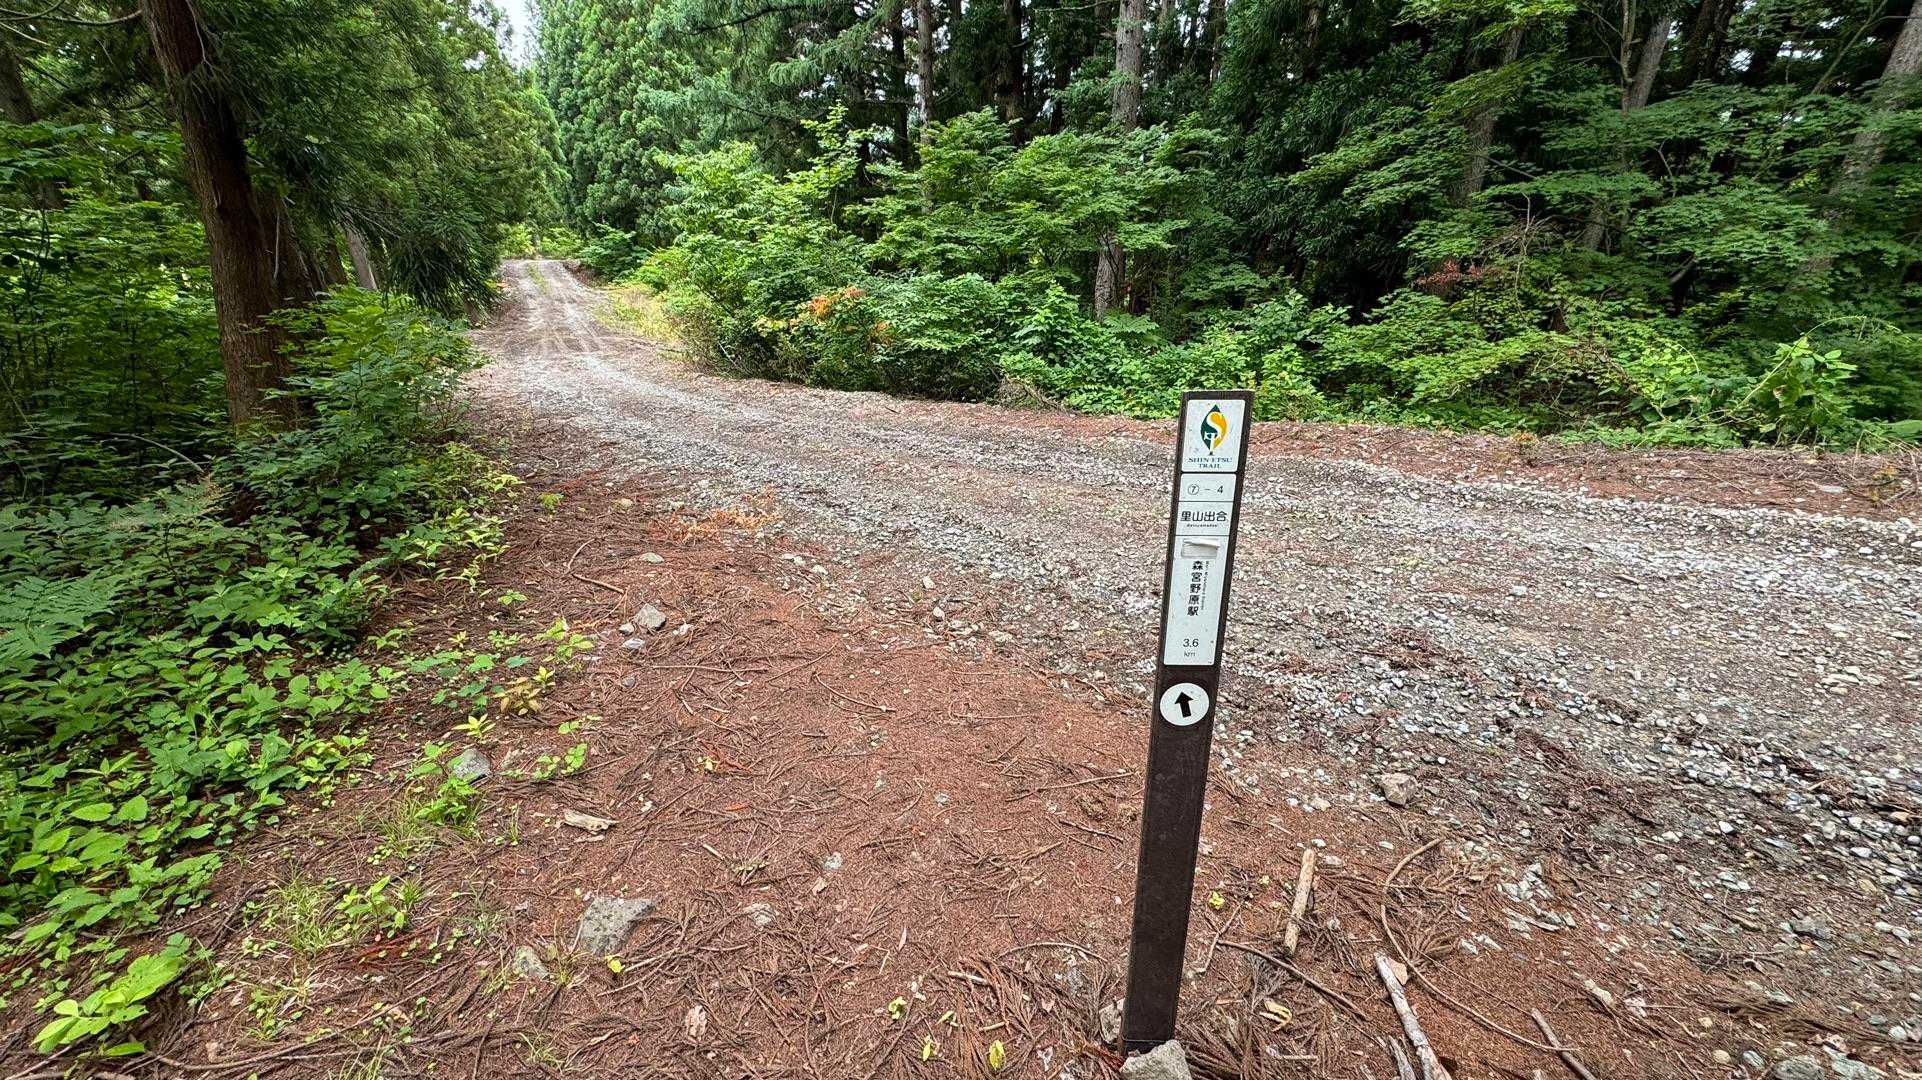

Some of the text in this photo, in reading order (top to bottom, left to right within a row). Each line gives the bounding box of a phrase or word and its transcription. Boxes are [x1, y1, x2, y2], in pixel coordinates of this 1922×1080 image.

[1216, 485, 1224, 494] 4
[1180, 510, 1228, 522] 里山出合
[1187, 560, 1204, 616] 森宮野原駅
[1182, 638, 1199, 648] 3.6
